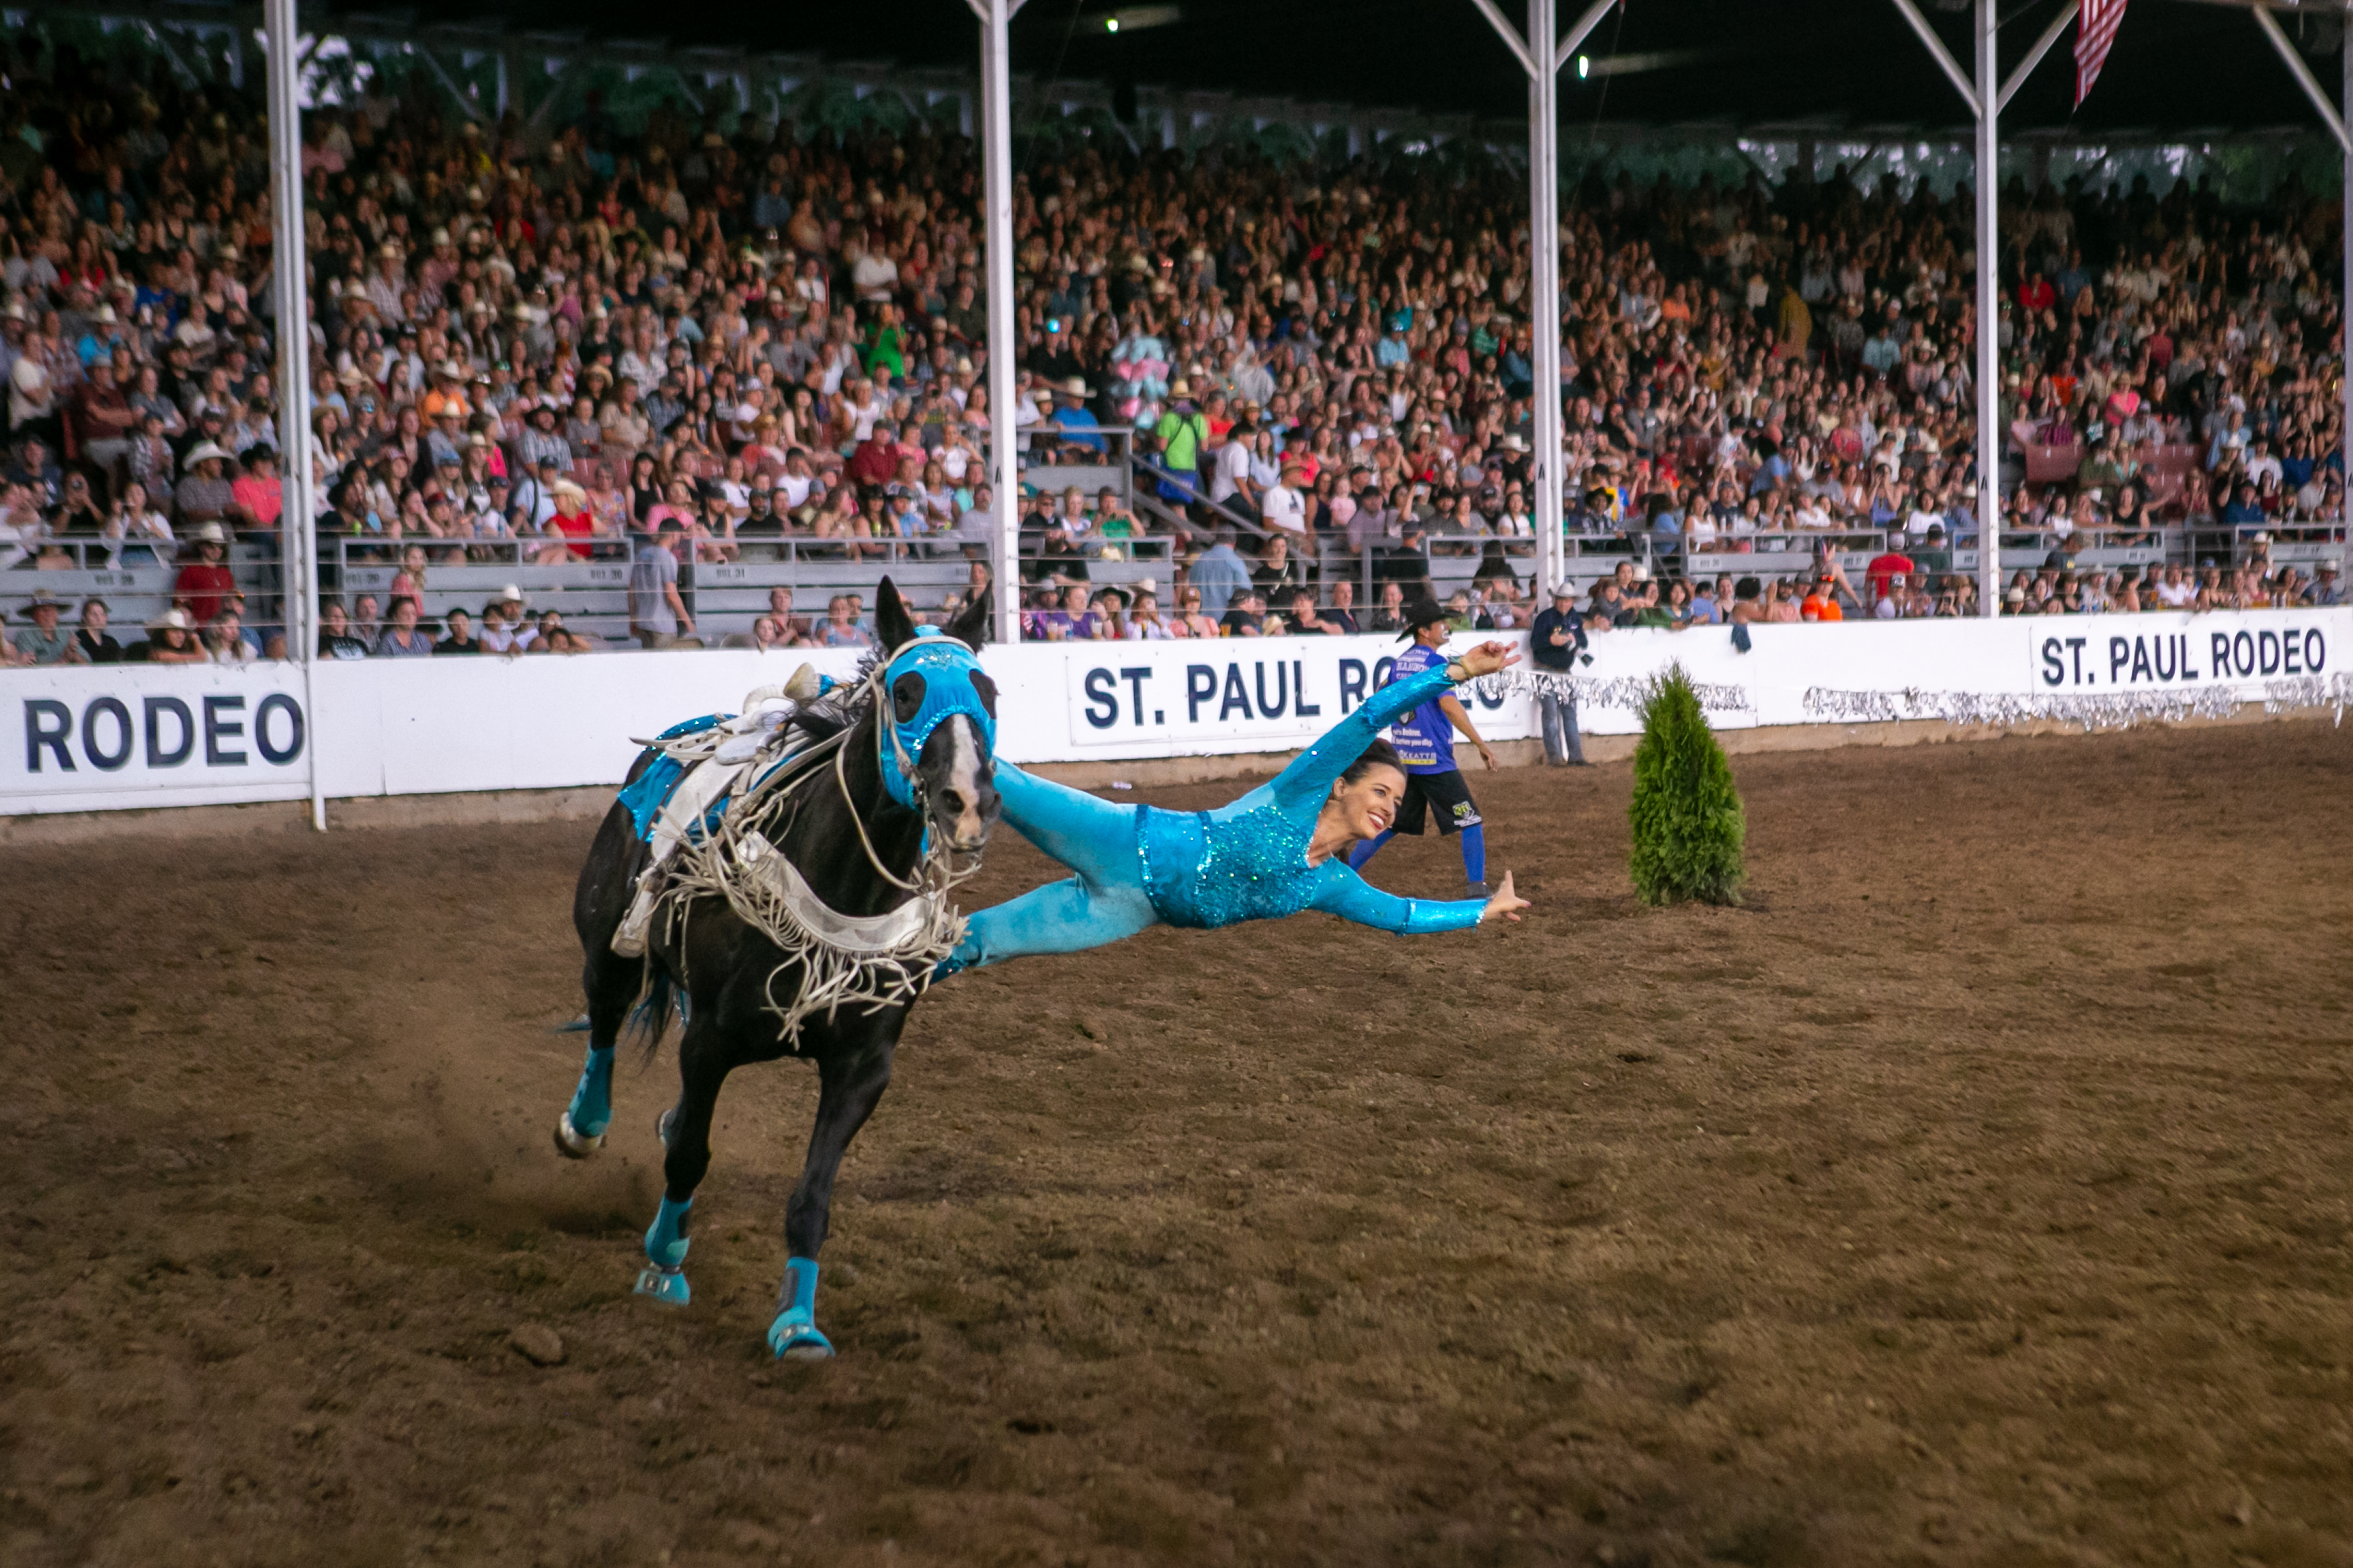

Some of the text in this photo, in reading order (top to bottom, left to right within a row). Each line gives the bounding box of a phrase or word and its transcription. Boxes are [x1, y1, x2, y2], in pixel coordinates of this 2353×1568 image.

[2042, 627, 2326, 687] ST. PAUL RODEO
[1084, 667, 1165, 730] ST.
[1187, 659, 1321, 724] PAUL
[23, 693, 304, 774] RODEO
